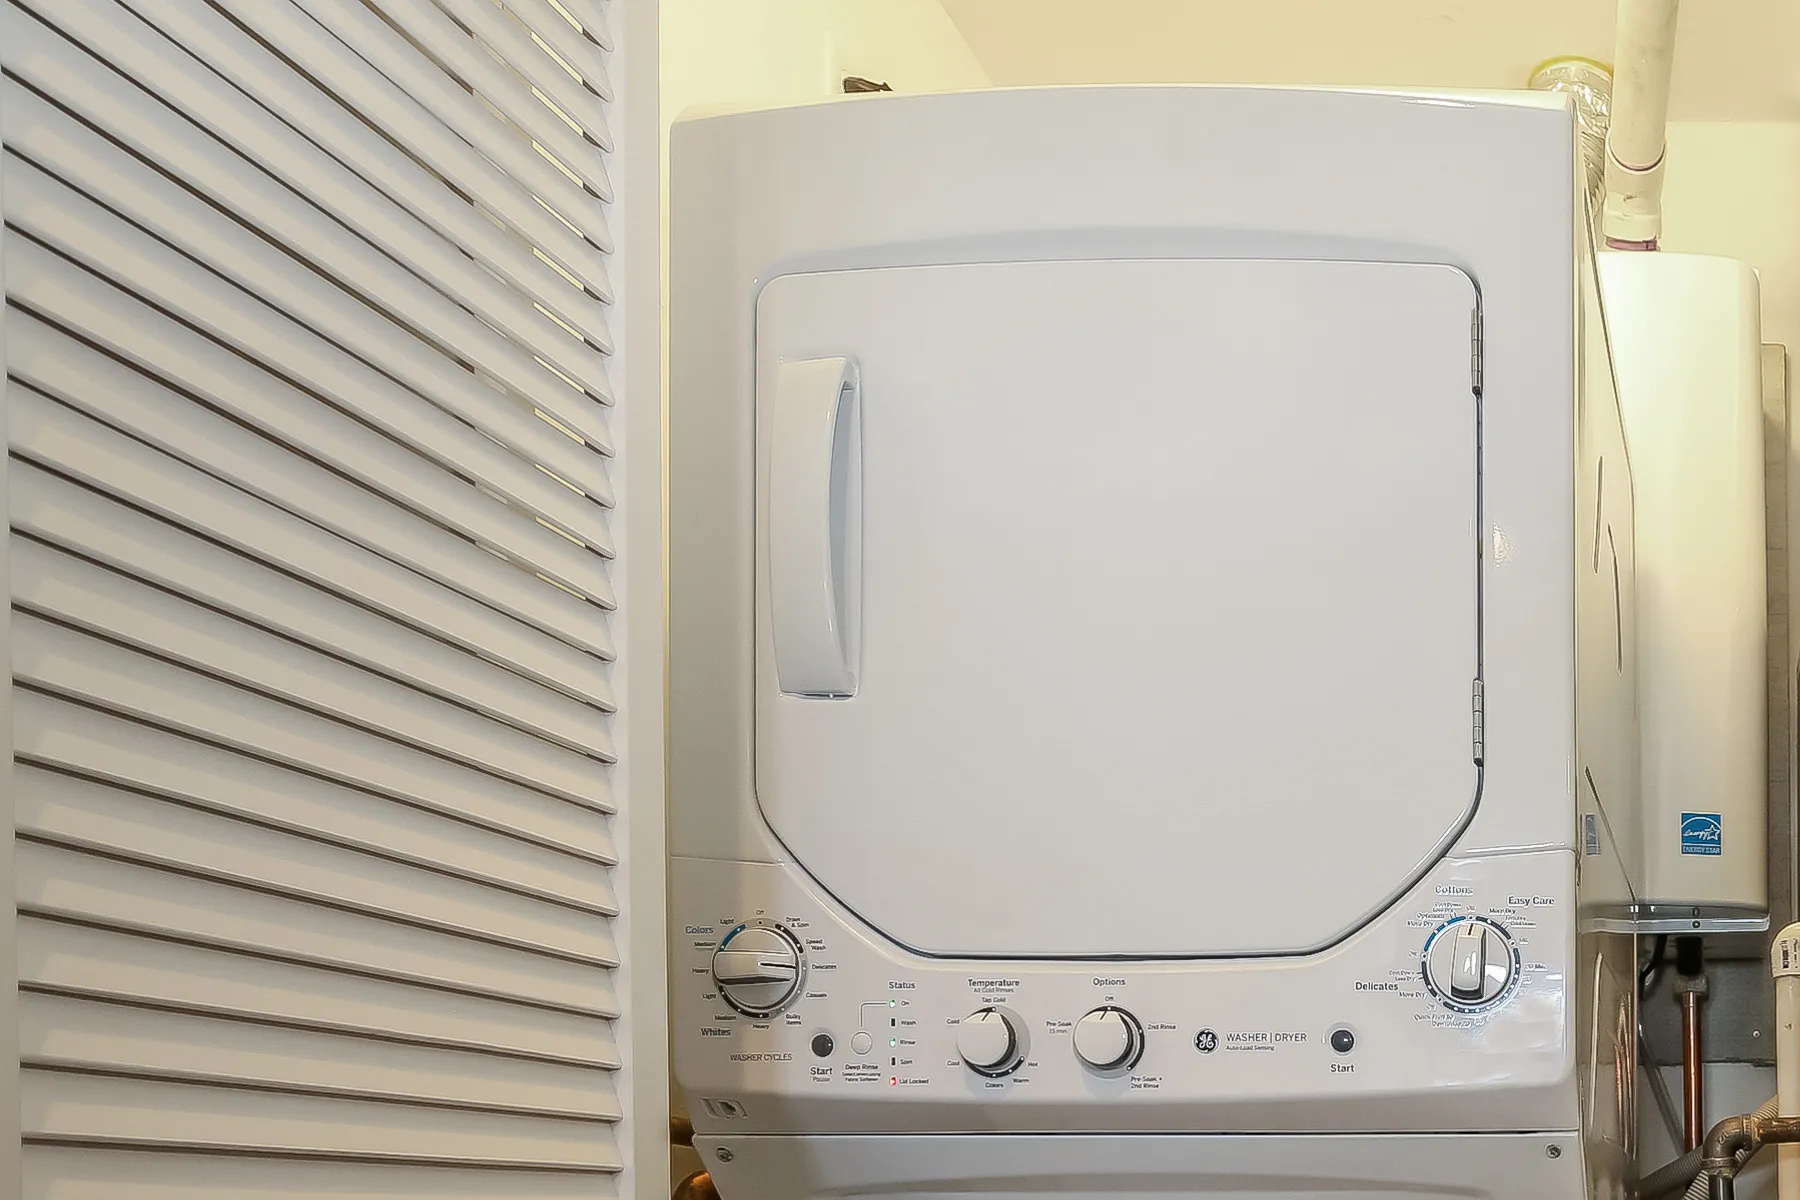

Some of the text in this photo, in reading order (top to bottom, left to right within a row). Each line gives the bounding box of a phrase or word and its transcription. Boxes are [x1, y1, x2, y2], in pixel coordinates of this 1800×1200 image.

[1435, 885, 1473, 895] Cottons
[1508, 896, 1555, 907] Easy Care
[686, 926, 714, 934] Colors
[889, 981, 916, 989] Status
[968, 979, 1020, 988] Temperature
[1093, 978, 1126, 987] Options
[1355, 982, 1399, 992] Delicates
[701, 1028, 732, 1036] Whites
[1226, 1033, 1307, 1042] WASHER DRYER
[730, 1053, 793, 1062] WASHER CYCLES
[810, 1067, 833, 1076] Start
[1330, 1063, 1355, 1073] Start
